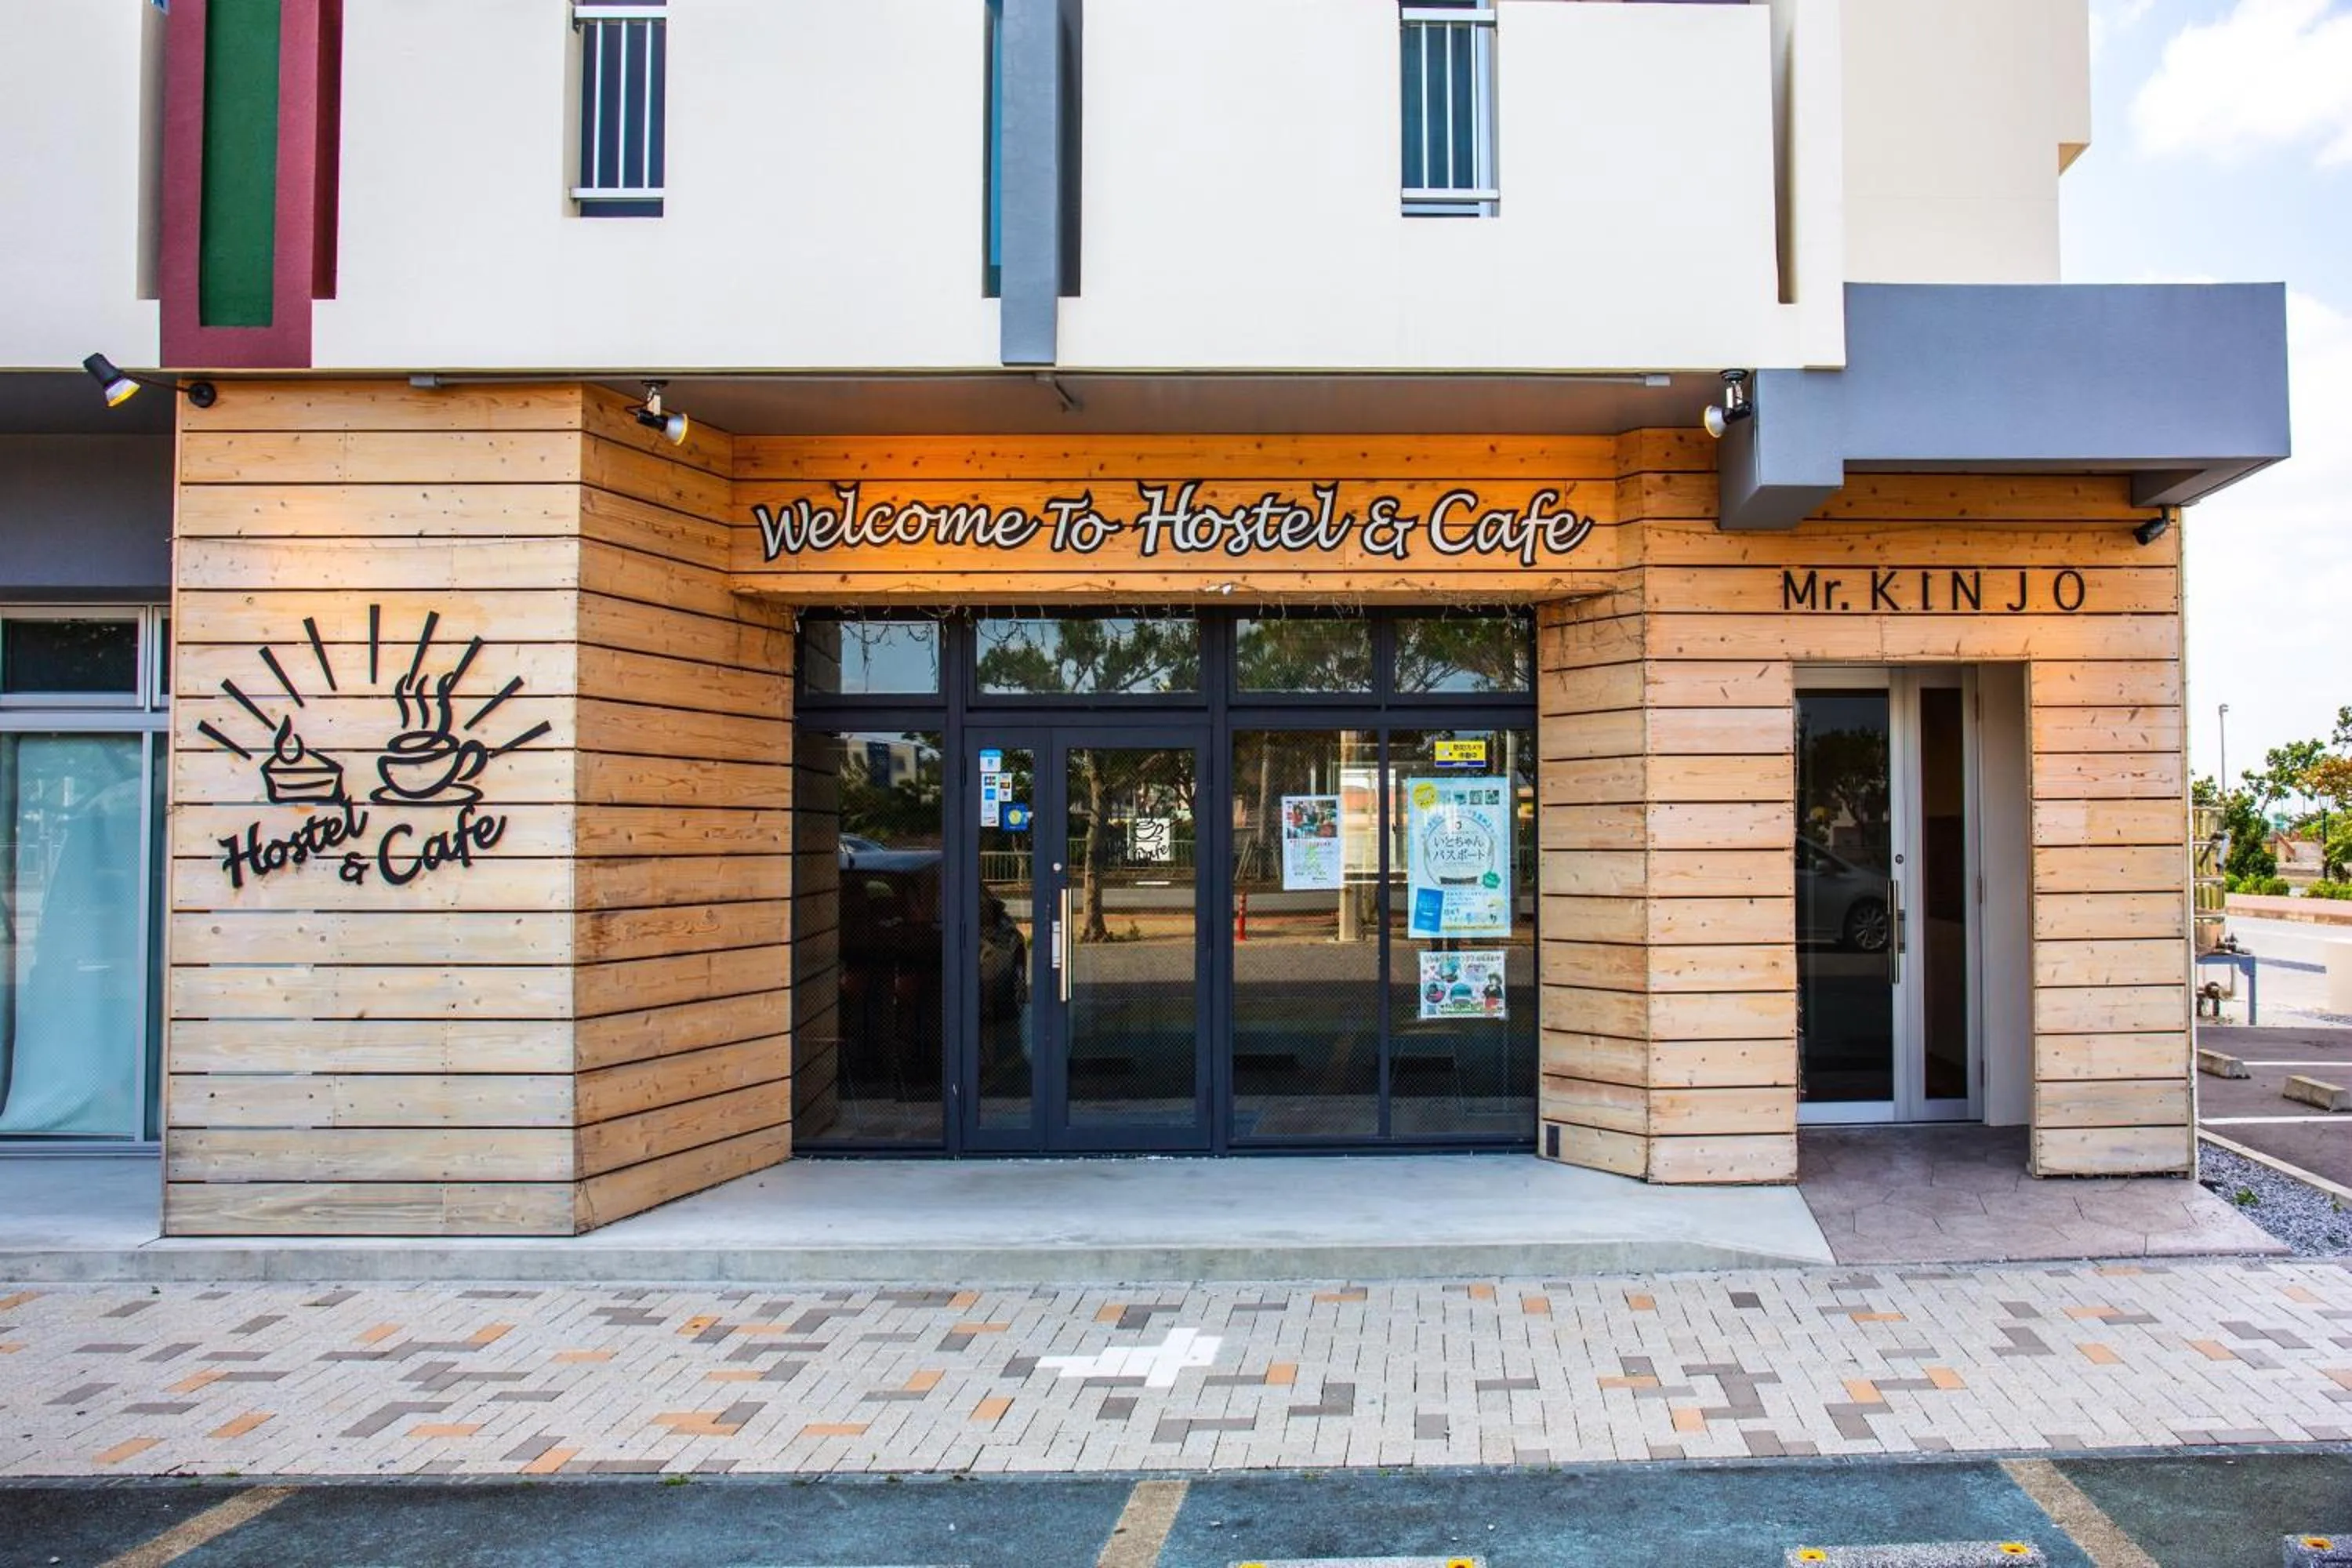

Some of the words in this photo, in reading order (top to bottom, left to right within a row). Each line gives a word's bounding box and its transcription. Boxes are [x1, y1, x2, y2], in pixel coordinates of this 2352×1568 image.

[753, 481, 1043, 562] Welcome
[1044, 489, 1122, 554] To
[1134, 480, 1358, 557] Hostel
[1361, 497, 1414, 560] &
[1426, 488, 1594, 567] Cafe
[1783, 571, 1849, 610] Mr.
[218, 795, 368, 888] Hostel
[339, 851, 368, 885] &
[377, 803, 507, 885] Cafe
